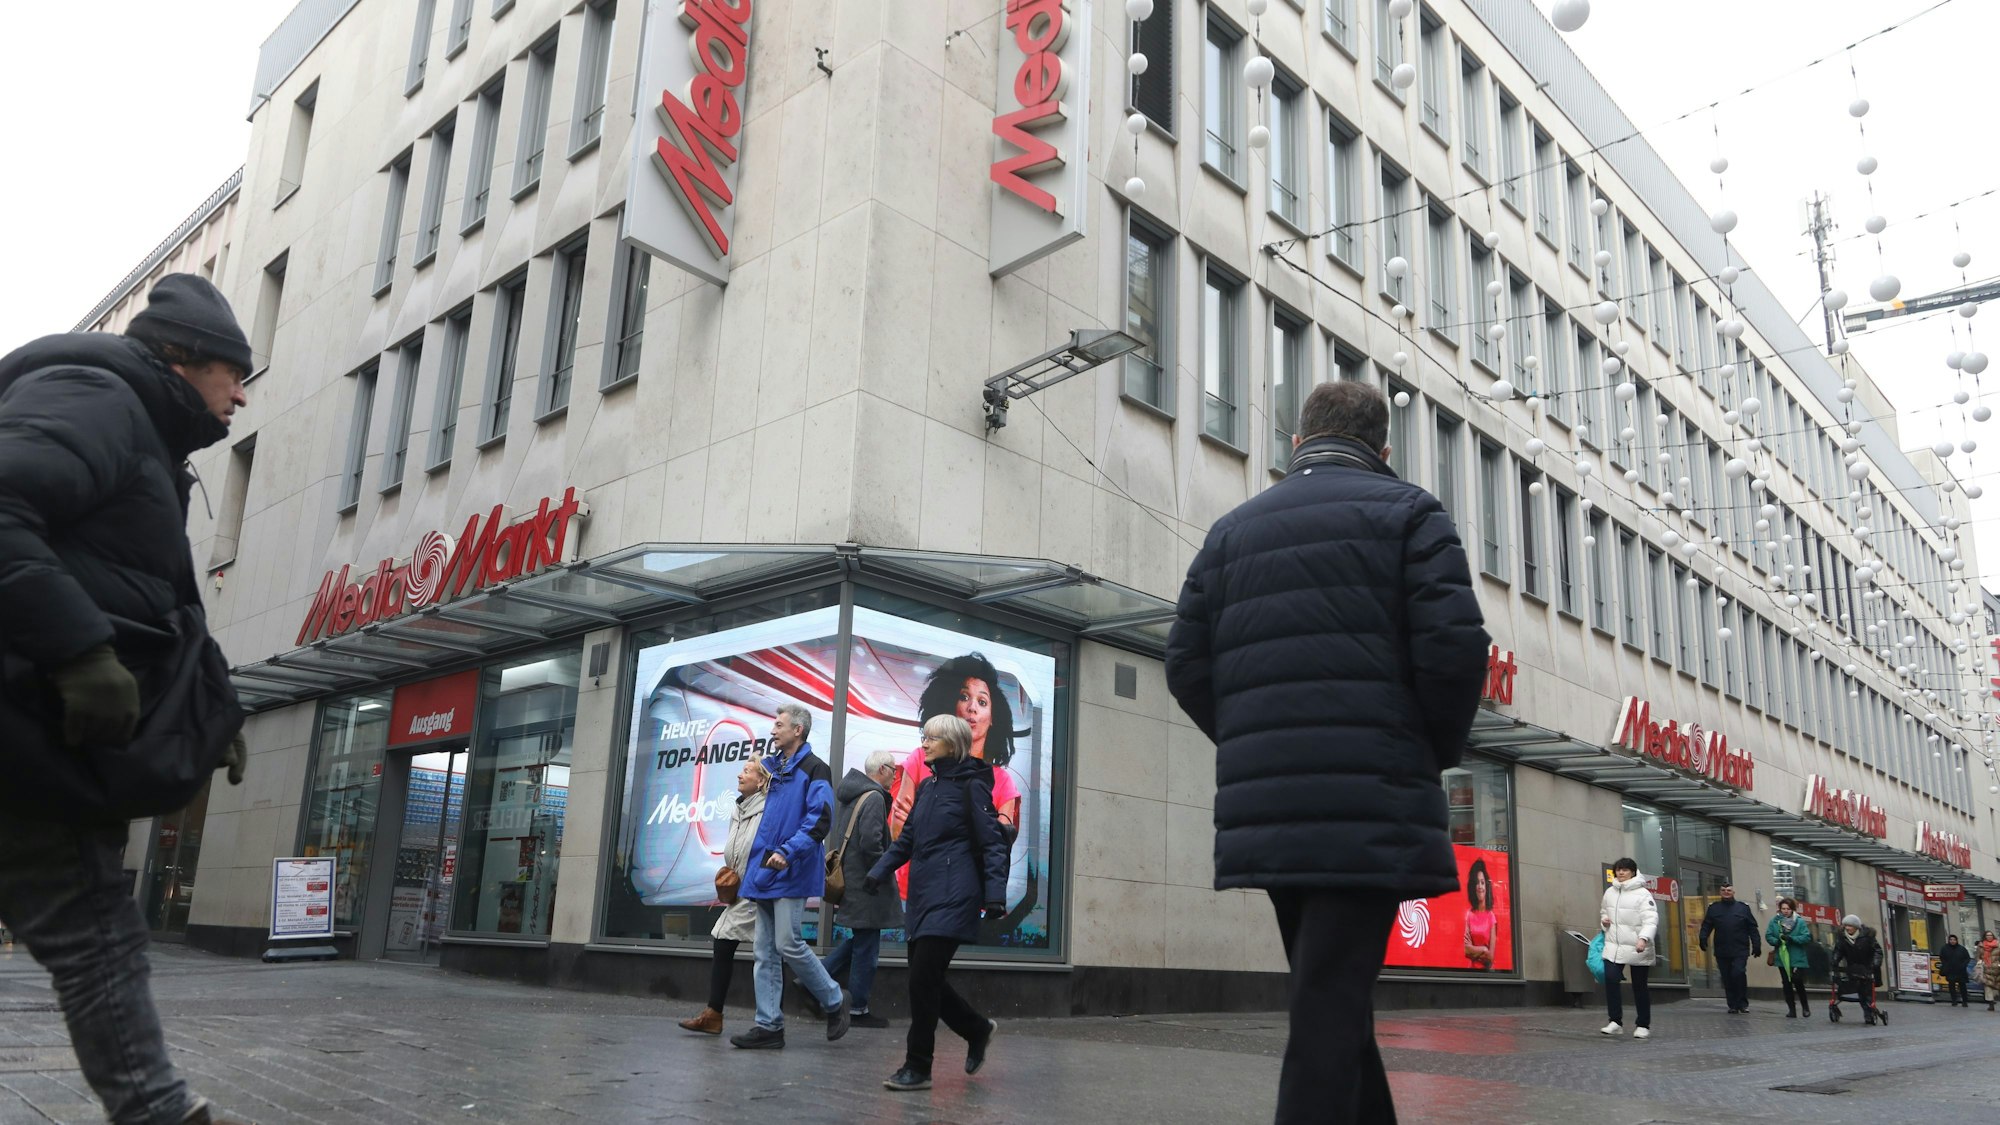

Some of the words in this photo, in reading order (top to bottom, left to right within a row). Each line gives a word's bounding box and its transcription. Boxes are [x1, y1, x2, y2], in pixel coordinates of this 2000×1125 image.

[295, 556, 409, 646] Media
[430, 486, 580, 603] Markt
[408, 707, 455, 736] Ausgang
[660, 718, 711, 741] HEUTE:
[656, 736, 780, 770] TOP-ANGEBO
[1616, 695, 1691, 769] Media
[1704, 730, 1755, 791] Markt
[647, 793, 716, 825] Media
[1808, 774, 1850, 827] Media
[1857, 794, 1887, 839] Markt
